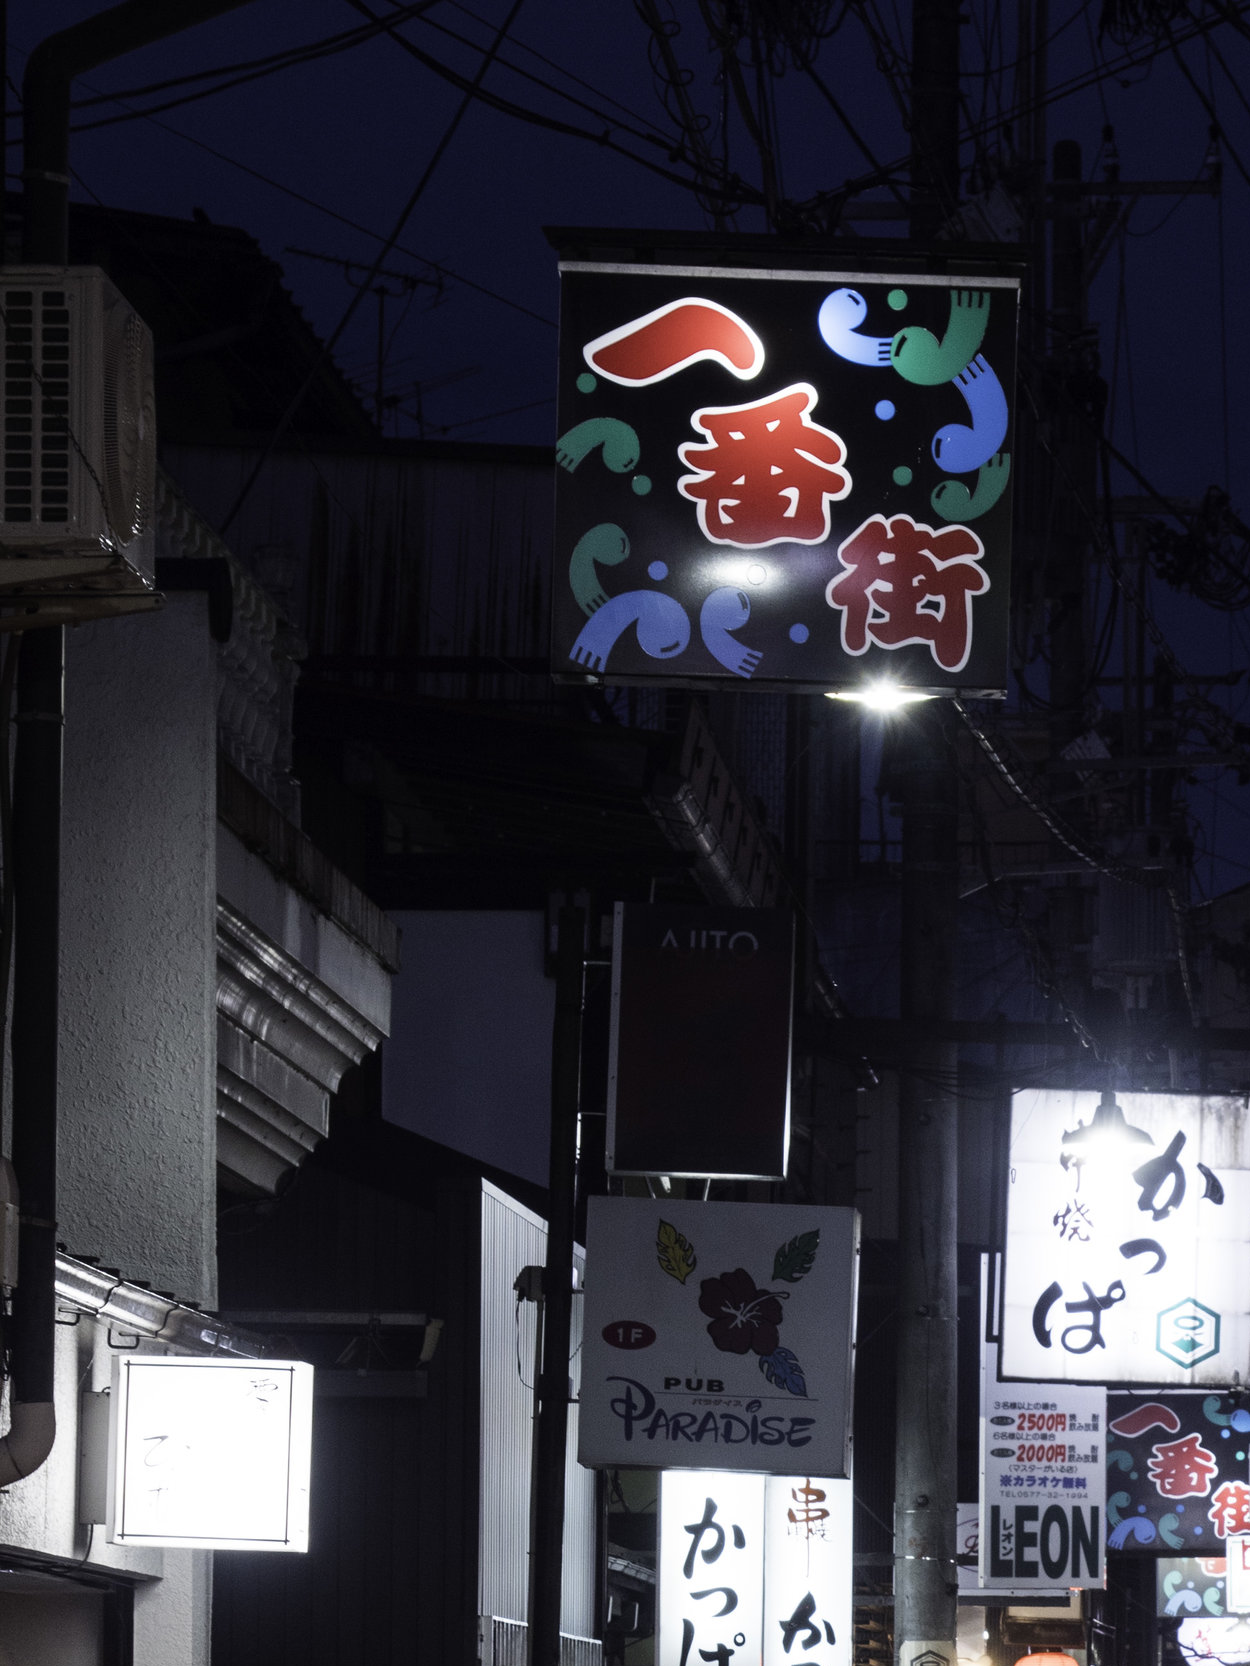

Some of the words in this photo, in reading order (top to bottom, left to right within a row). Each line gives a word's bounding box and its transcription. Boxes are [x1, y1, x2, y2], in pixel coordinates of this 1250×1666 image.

[583, 297, 990, 672] 一番街
[1033, 1130, 1224, 1354] かっぱ
[616, 1328, 643, 1343] 1F
[664, 1377, 725, 1393] PUB
[1017, 1413, 1067, 1432] 2500円
[1016, 1444, 1067, 1463] 2000円
[990, 1504, 1099, 1580] LEON
[1001, 1519, 1014, 1557] レオン
